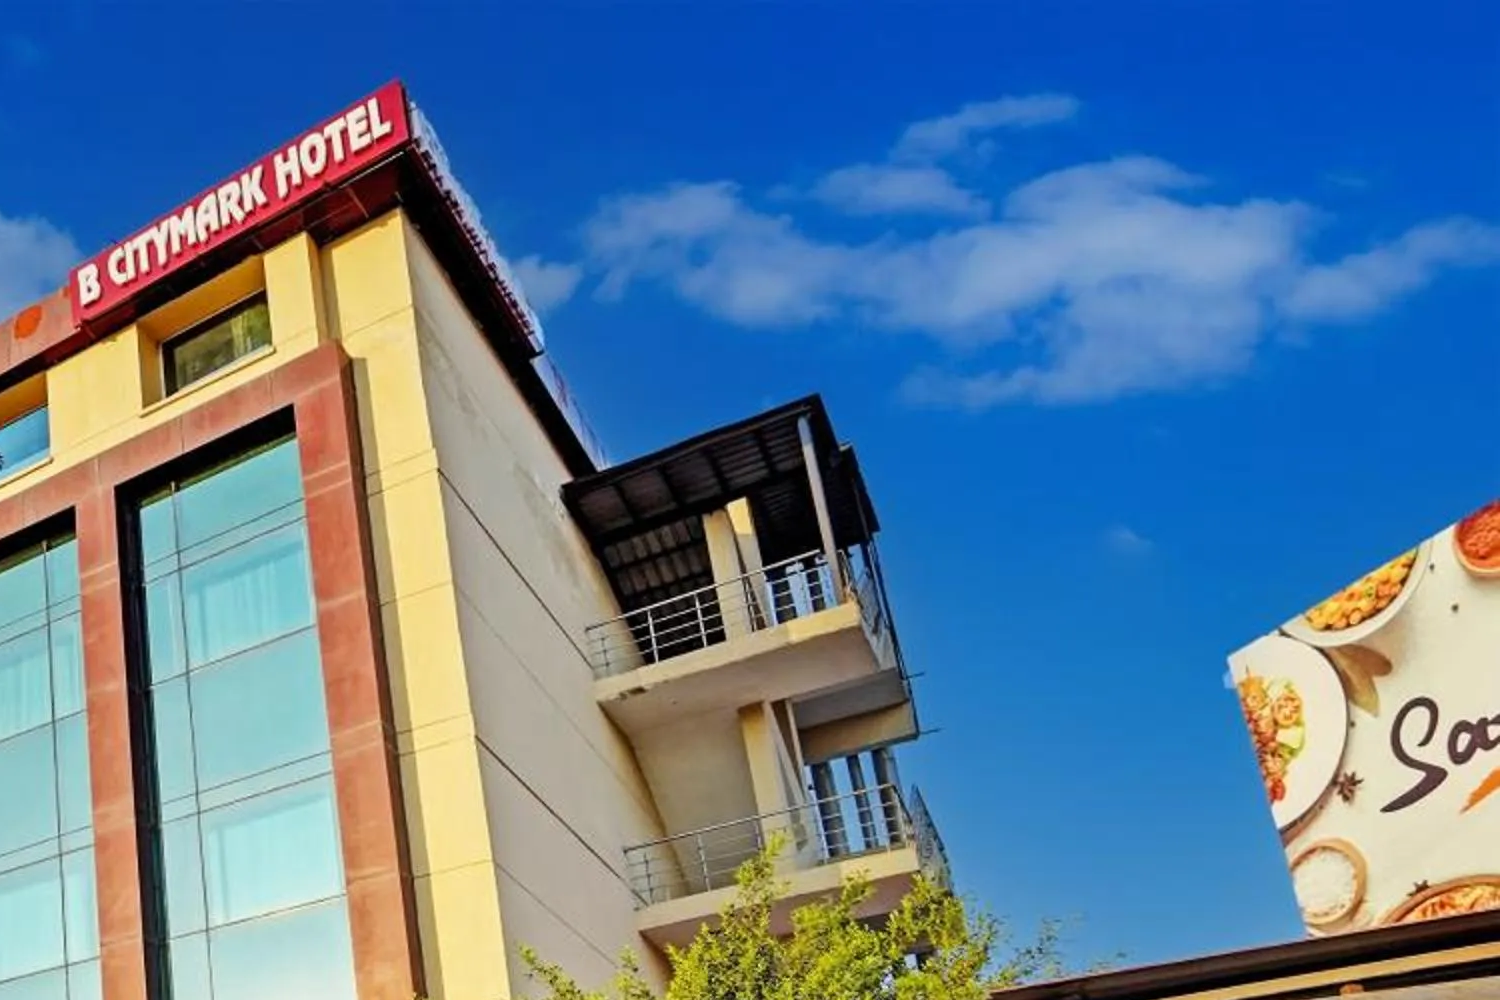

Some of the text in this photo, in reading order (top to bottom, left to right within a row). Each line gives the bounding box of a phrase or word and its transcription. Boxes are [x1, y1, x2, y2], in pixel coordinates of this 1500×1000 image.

[77, 97, 393, 307] B CITYMARK HOTEL
